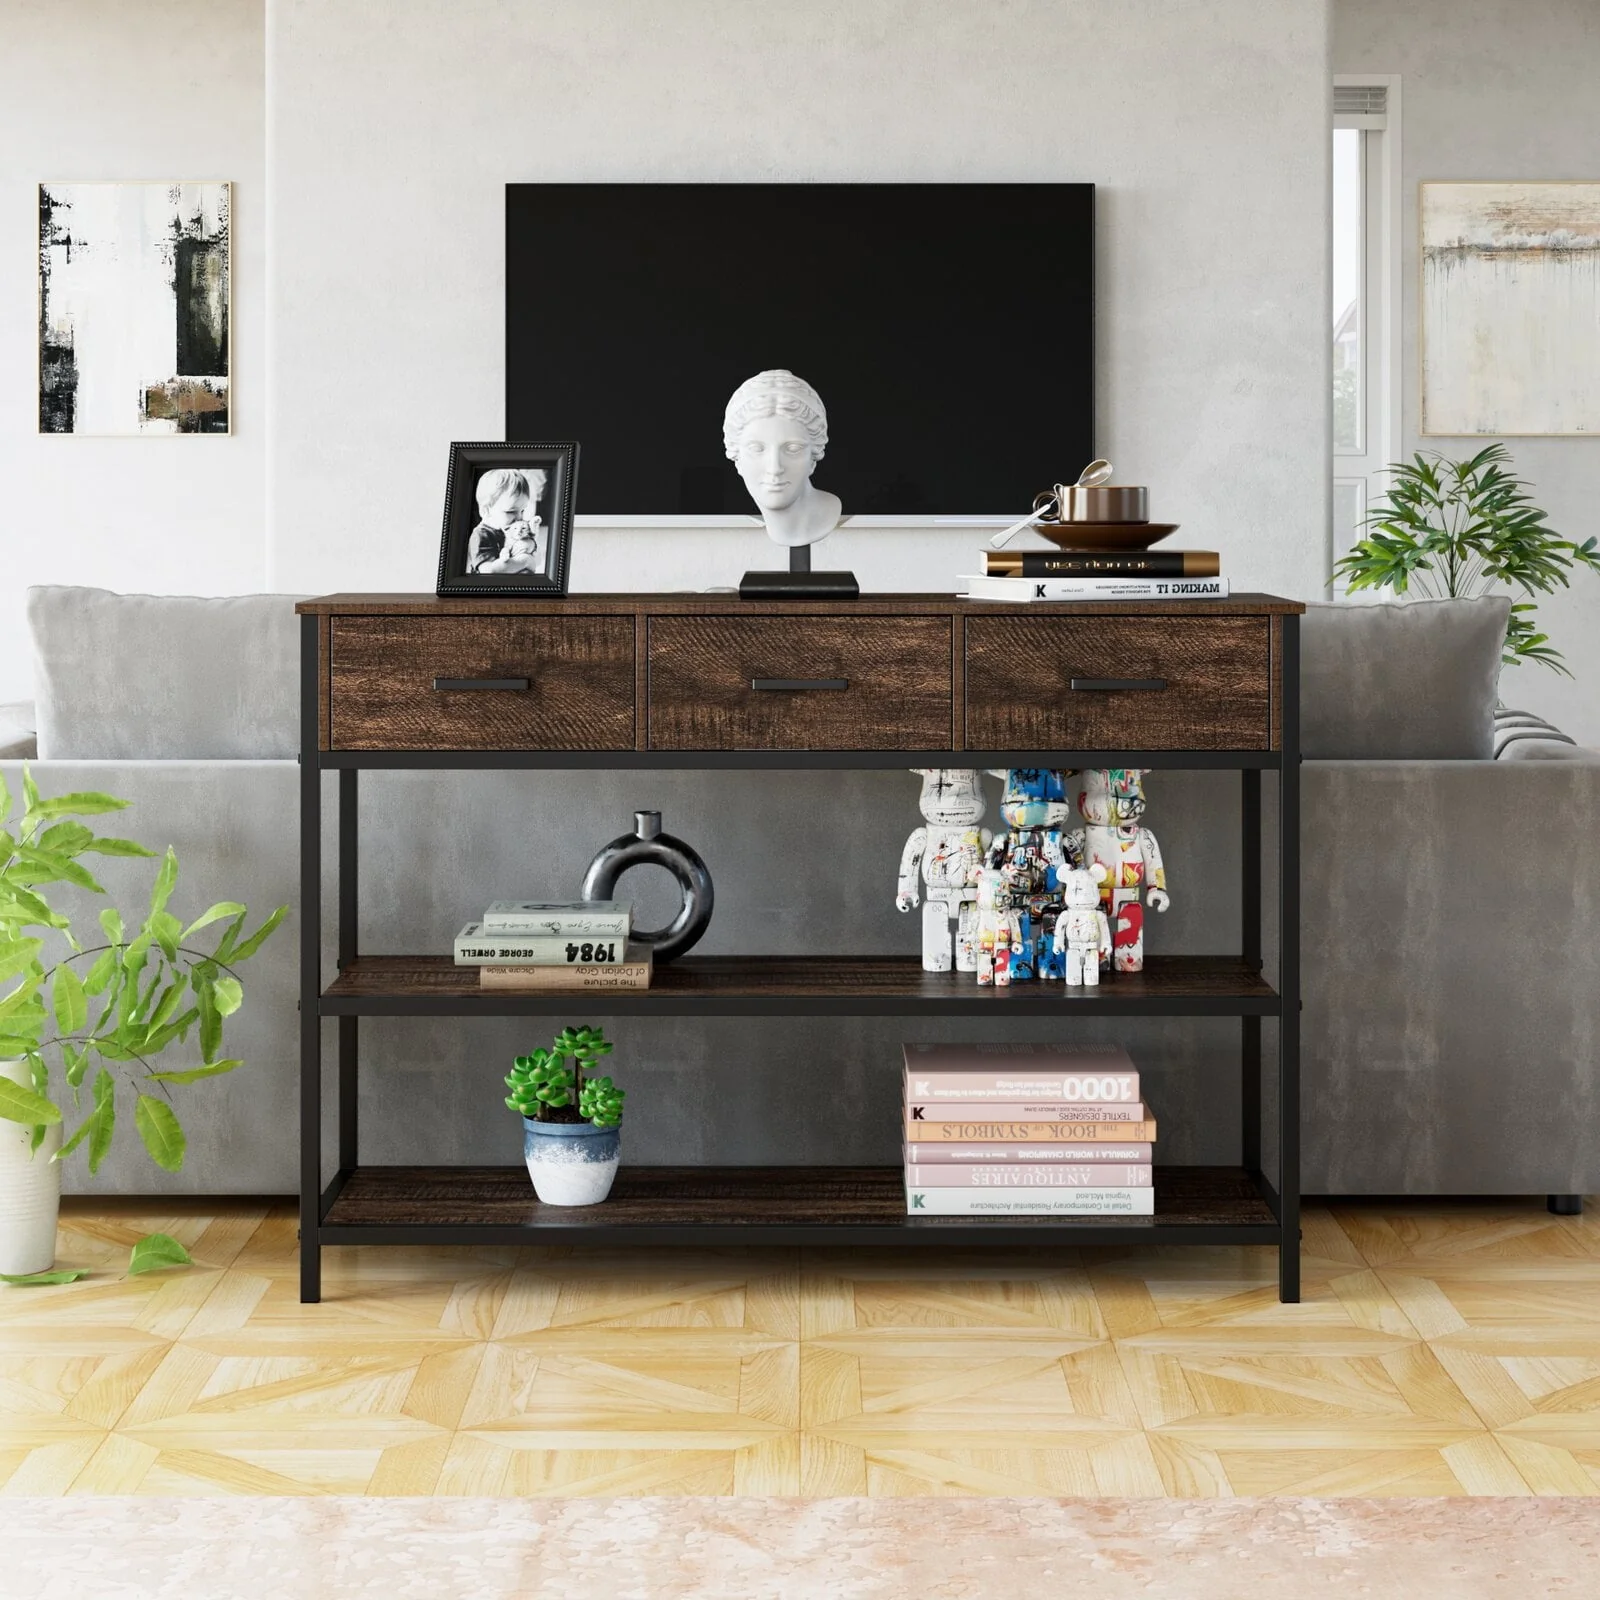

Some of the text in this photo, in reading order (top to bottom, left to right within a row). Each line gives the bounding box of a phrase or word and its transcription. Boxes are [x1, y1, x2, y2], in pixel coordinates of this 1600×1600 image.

[461, 949, 534, 957] GEORGE ORWELL
[565, 943, 615, 962] 1984
[575, 966, 645, 976] of Dorian Gray
[584, 978, 618, 986] picture
[1063, 1077, 1132, 1100] 1000
[913, 1107, 925, 1120] K
[942, 1124, 1028, 1138] SYMBOLS
[1049, 1124, 1097, 1138] BOOK
[1065, 1150, 1093, 1158] WORLD
[1101, 1150, 1139, 1158] FORMULA
[971, 1172, 1091, 1184] ANTIQUAIRES
[914, 1195, 925, 1208] K
[1105, 1192, 1131, 1200] Virginia
[1054, 1201, 1102, 1210] Contemporary
